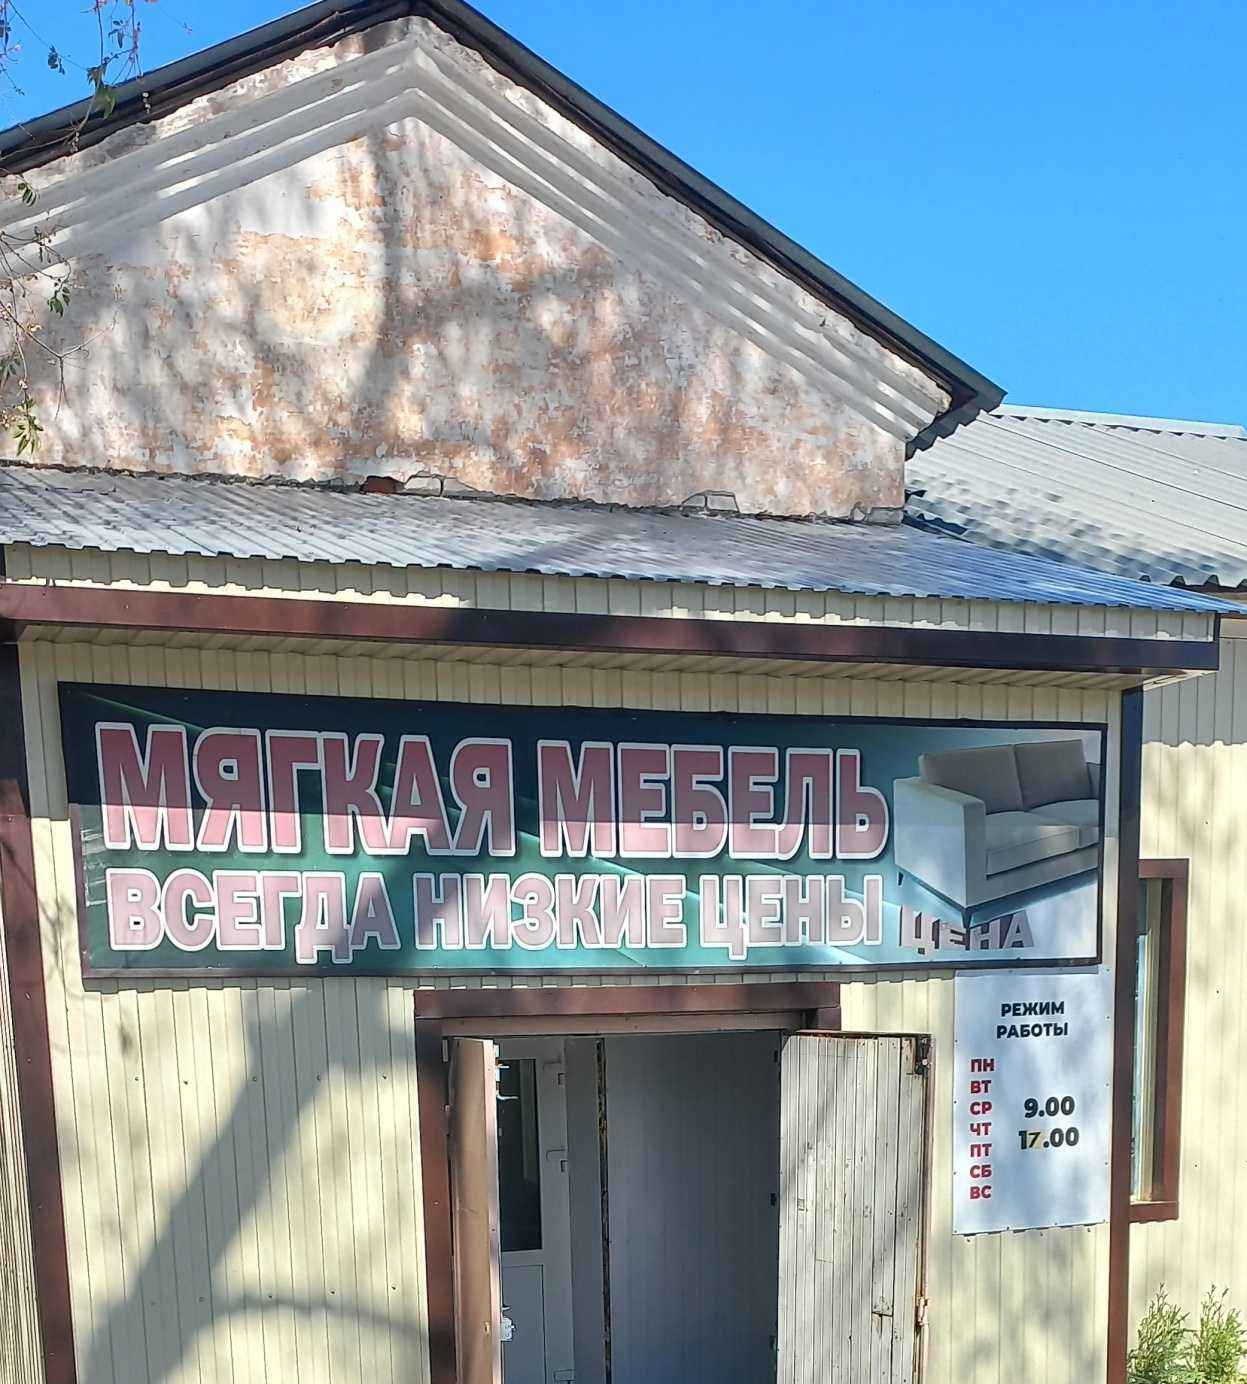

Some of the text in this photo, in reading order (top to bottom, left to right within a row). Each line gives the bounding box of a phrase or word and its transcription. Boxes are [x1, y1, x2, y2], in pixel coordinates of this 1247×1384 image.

[95, 722, 890, 860] МЯГКАЯ МЕБЕЛЬ
[105, 868, 883, 965] ВСЕГДА НИЗКИЕ ЦЕНЫ
[1001, 1001, 1065, 1017] РЕЖИМ
[997, 1023, 1069, 1039] РАБОТЫ
[970, 1058, 995, 1072] ПН
[970, 1080, 992, 1093] ВТ
[970, 1102, 992, 1115] СР
[1024, 1096, 1075, 1118] 9.00
[970, 1122, 992, 1136] ЧТ
[1018, 1127, 1080, 1149] 17.00
[970, 1143, 992, 1157] ПТ
[970, 1165, 992, 1178] СБ
[970, 1185, 992, 1199] ВС
